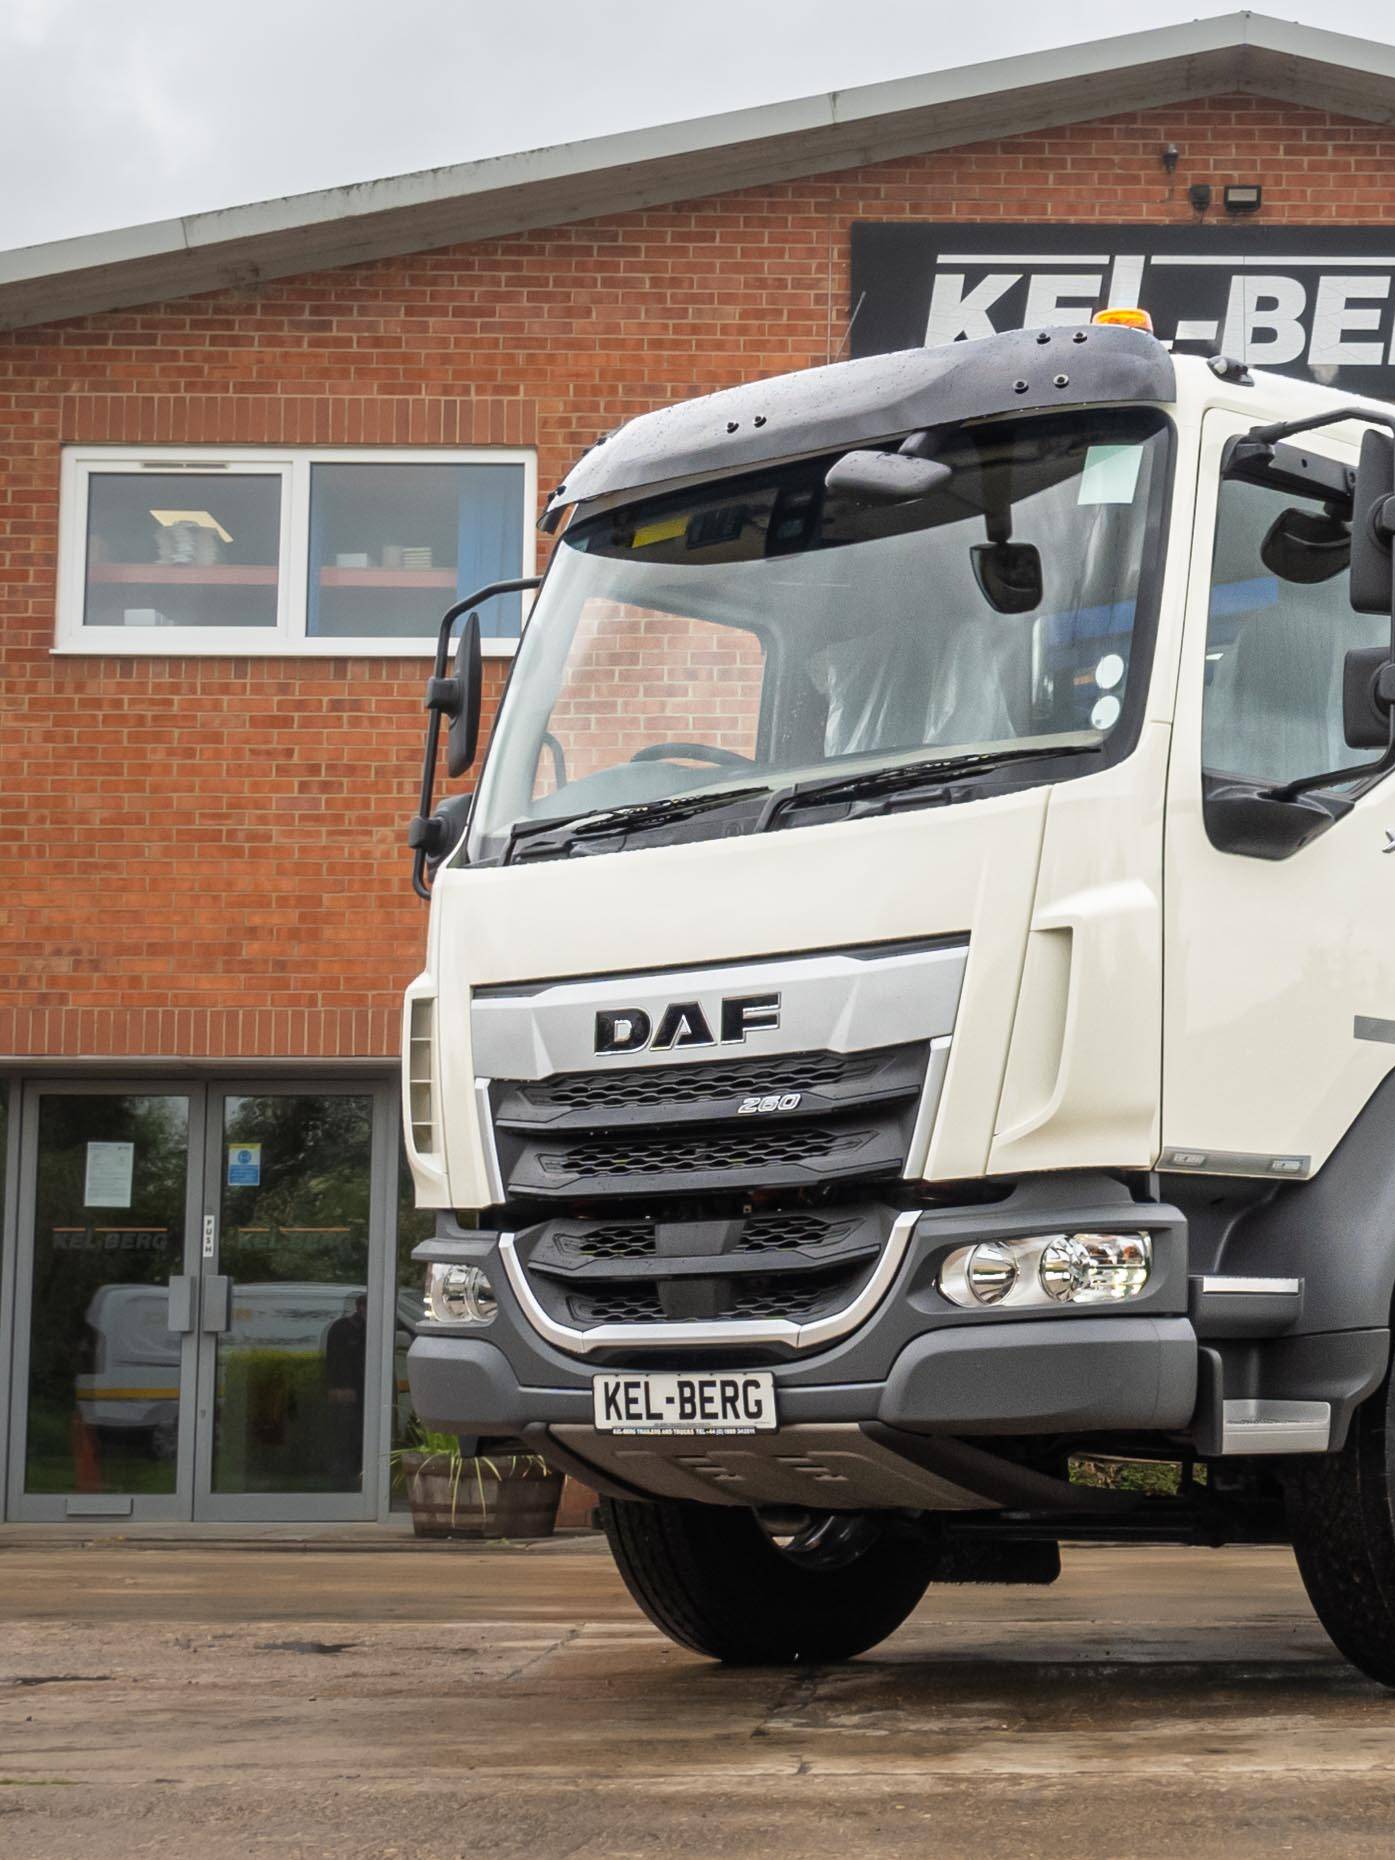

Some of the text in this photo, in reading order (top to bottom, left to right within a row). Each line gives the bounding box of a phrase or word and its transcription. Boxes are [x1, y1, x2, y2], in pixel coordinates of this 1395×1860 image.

[595, 992, 781, 1055] DAF
[738, 1094, 801, 1114] 260
[604, 1379, 763, 1421] KEL-BERG
